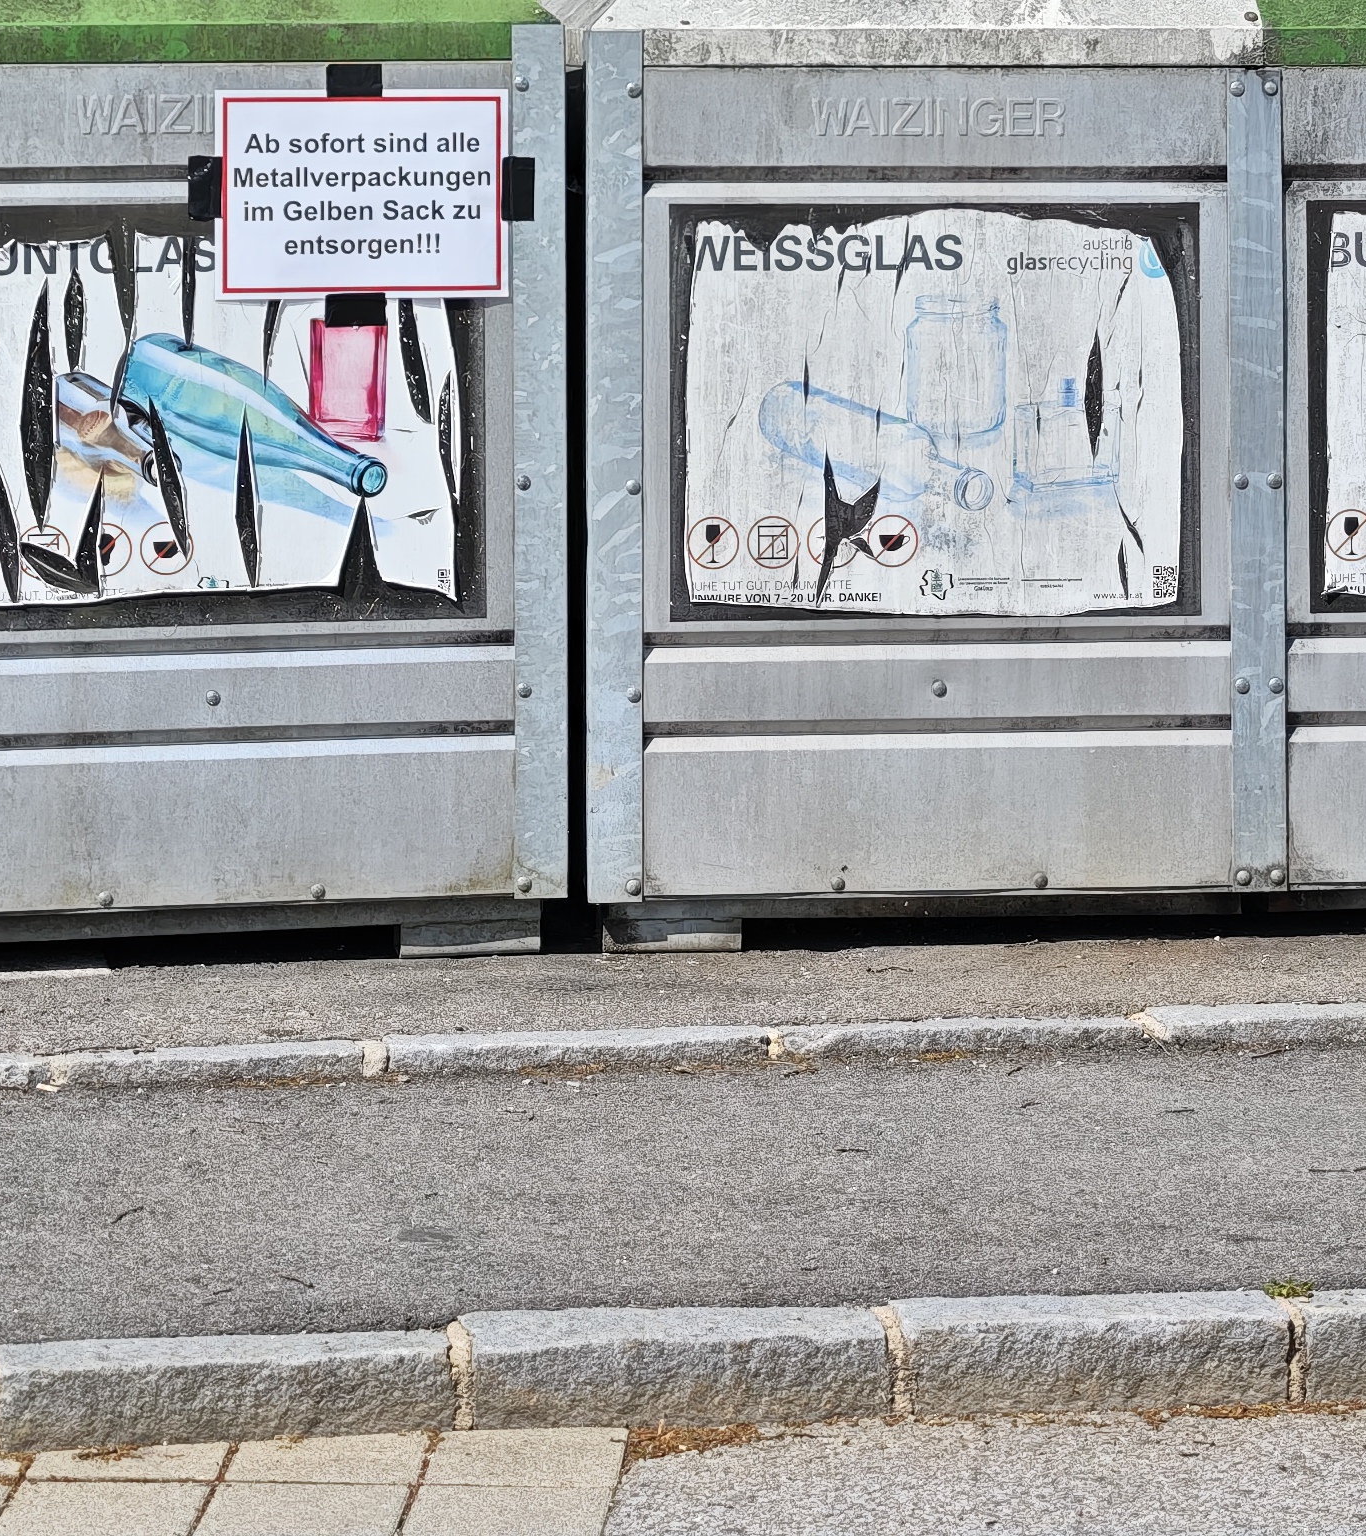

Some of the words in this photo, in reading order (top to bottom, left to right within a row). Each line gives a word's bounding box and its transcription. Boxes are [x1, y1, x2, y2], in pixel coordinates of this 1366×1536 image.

[77, 93, 214, 135] WAIZI
[810, 96, 1066, 137] WAIZINGER
[245, 134, 279, 153] Ab
[290, 133, 364, 153] sofort
[374, 133, 426, 152] sind
[437, 133, 479, 152] alle
[234, 167, 490, 191] Metallverpackungen
[245, 202, 273, 221] im
[284, 201, 372, 221] Gelben
[383, 200, 444, 220] Sack
[453, 205, 480, 219] zu
[285, 234, 439, 259] entsorgen!!!
[1083, 235, 1133, 251] austria
[1007, 252, 1133, 275] glasrecycling
[694, 581, 718, 591] UHE
[721, 580, 743, 591] TUT
[695, 594, 742, 603] INWURF
[745, 593, 771, 603] VON
[807, 593, 835, 603] UR.
[839, 592, 882, 602] DANKE!
